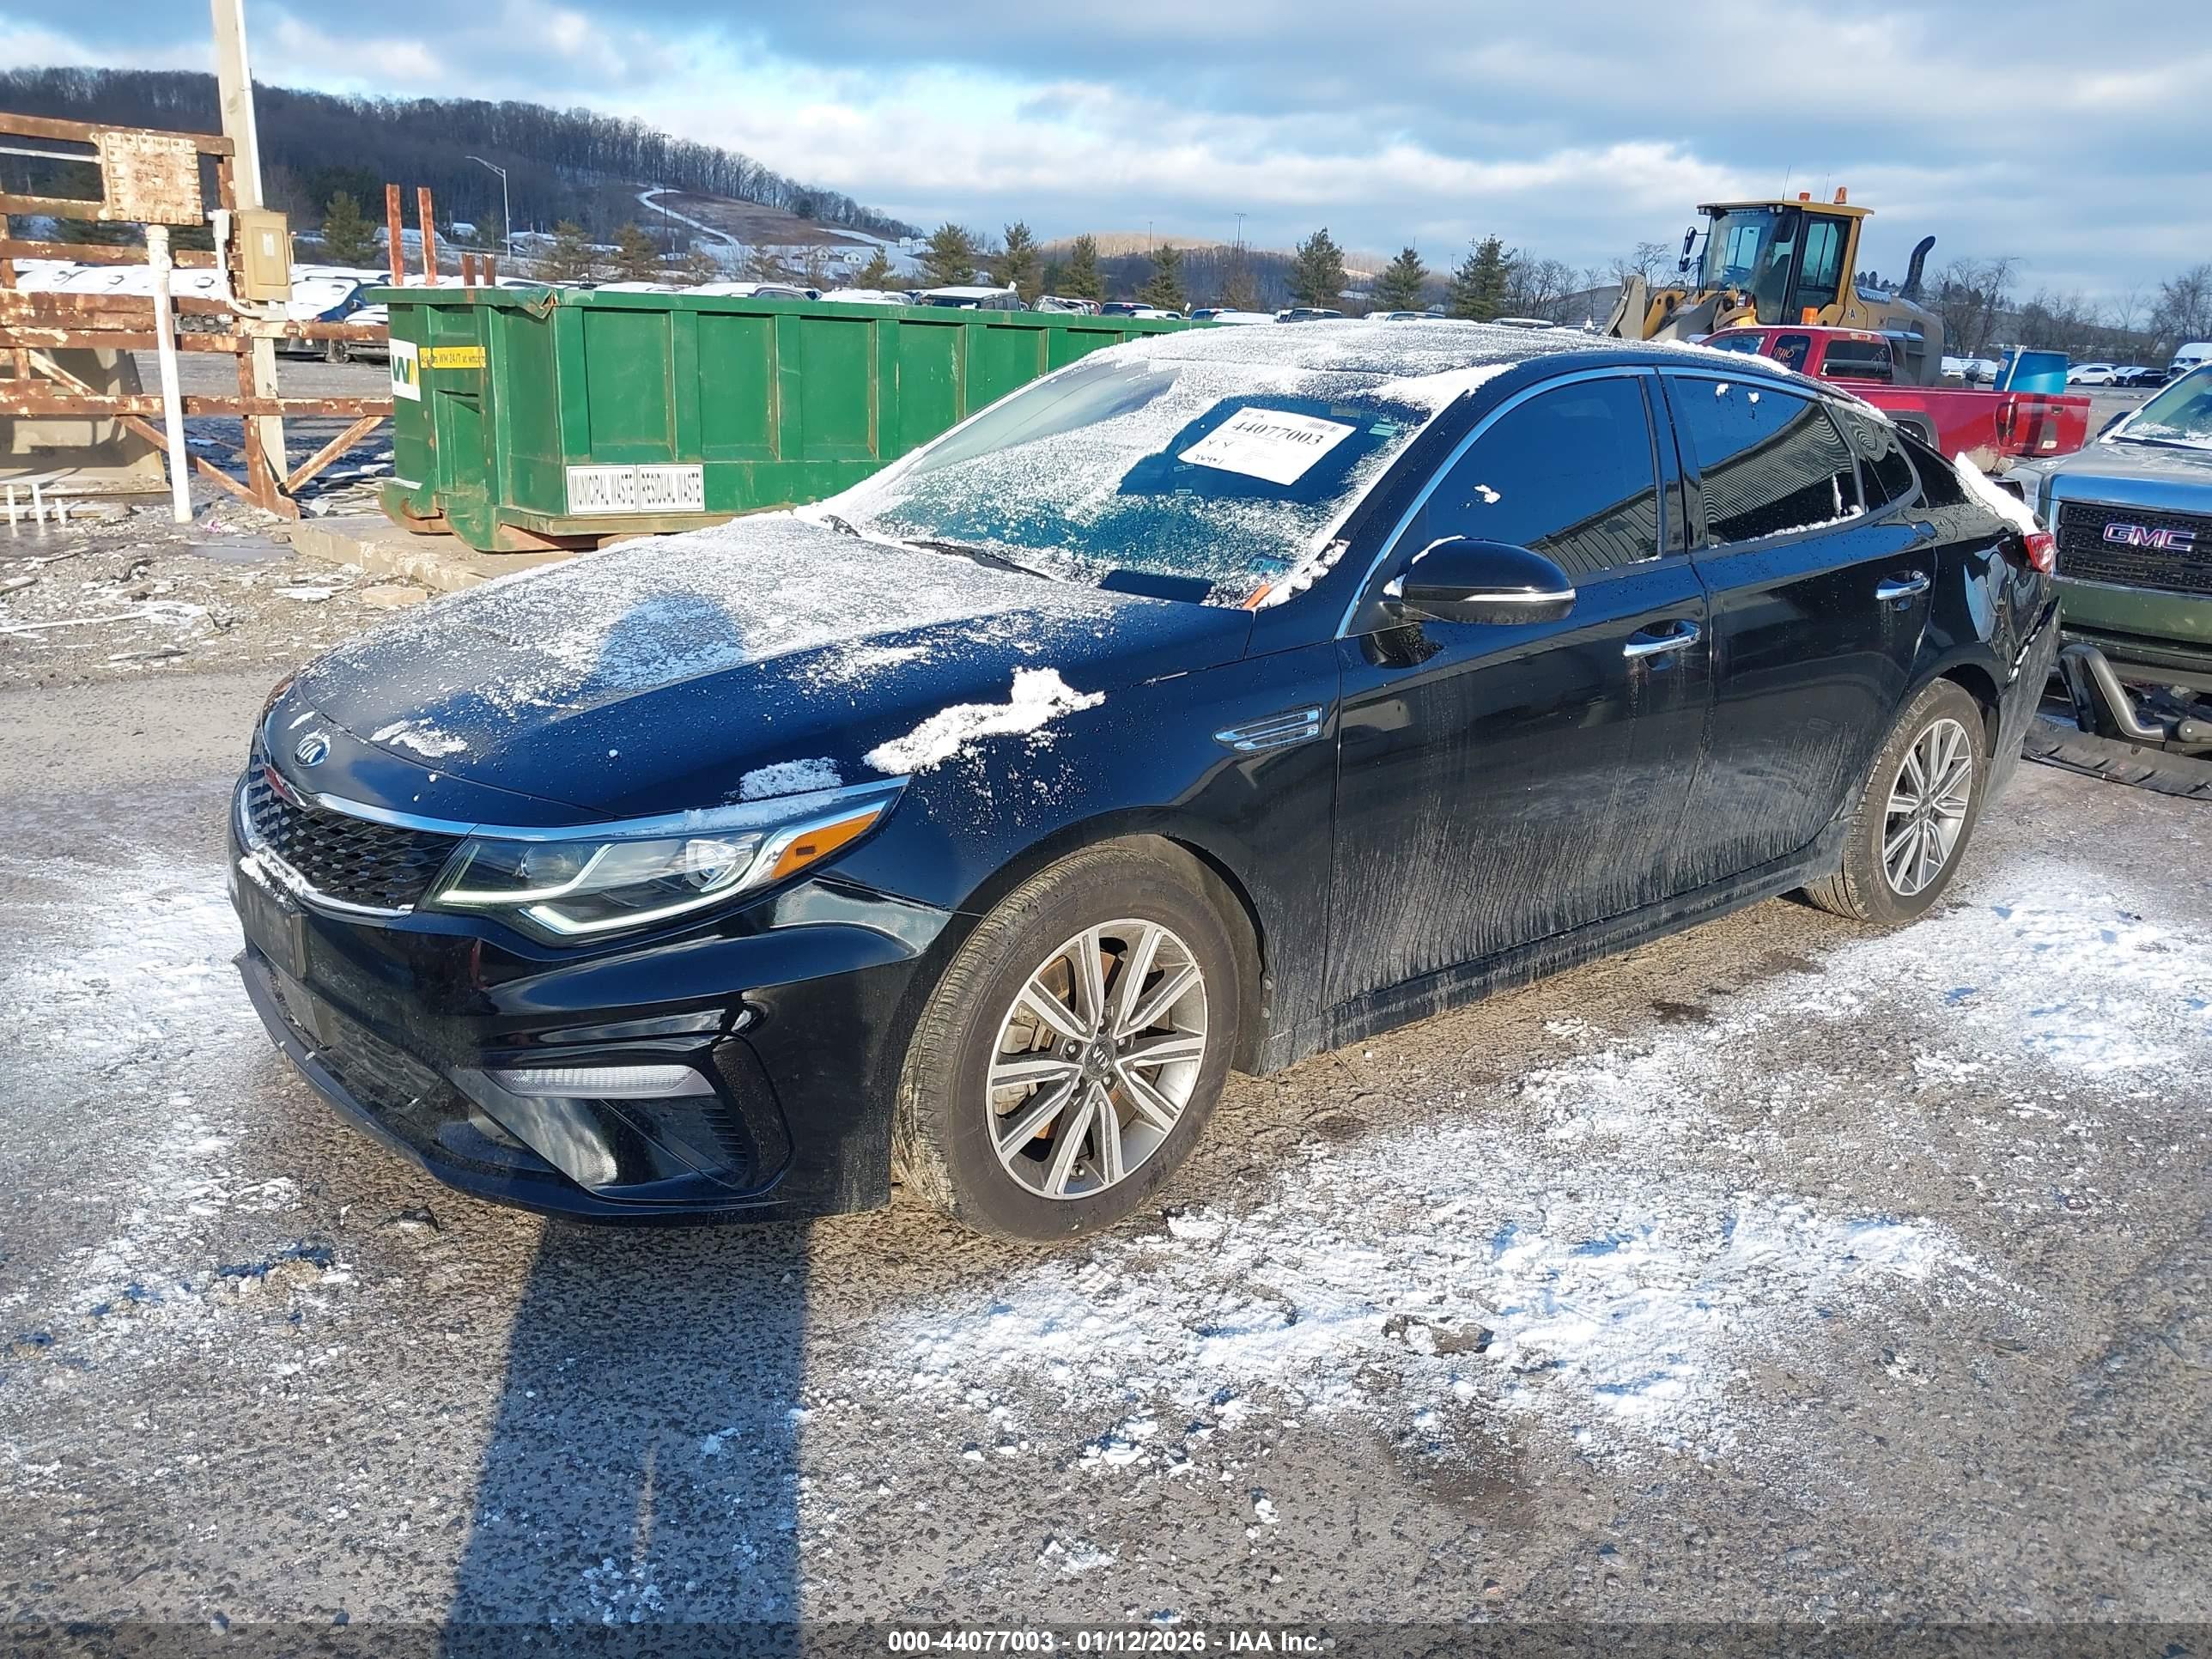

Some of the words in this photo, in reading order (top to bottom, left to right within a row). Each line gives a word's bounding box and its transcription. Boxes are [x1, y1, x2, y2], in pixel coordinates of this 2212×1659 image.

[1232, 421, 1324, 446] 44077003
[571, 474, 609, 506] MUNICIPAL
[610, 473, 635, 505] WASTE
[641, 473, 676, 504] RESIDUAL
[677, 472, 701, 503] WASTE
[2103, 523, 2196, 552] GMC
[1092, 1045, 1110, 1071] KIA
